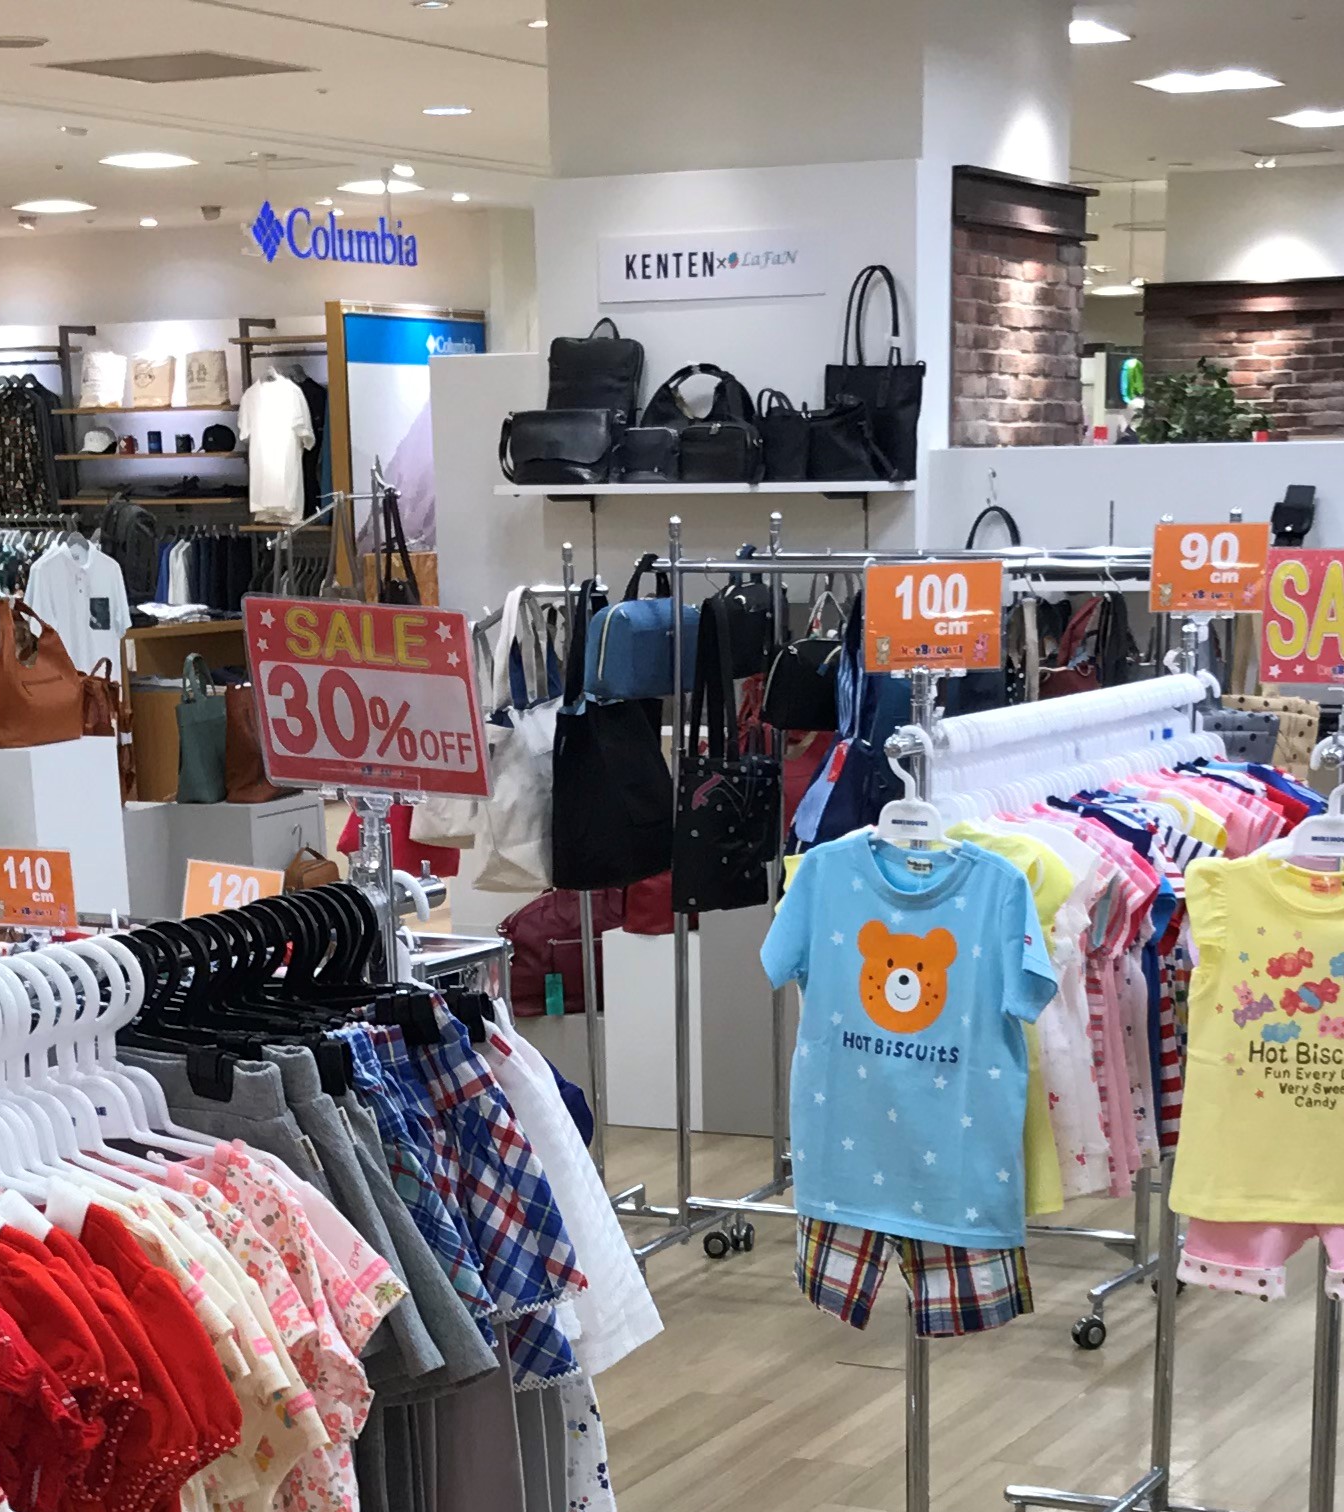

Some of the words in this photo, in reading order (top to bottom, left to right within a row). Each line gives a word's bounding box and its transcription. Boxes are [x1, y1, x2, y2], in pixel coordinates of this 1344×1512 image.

[286, 207, 418, 266] Columbia
[625, 251, 715, 279] KENTEN
[1180, 532, 1240, 570] 90
[1210, 570, 1239, 584] cm
[895, 573, 968, 619] 100
[284, 607, 431, 669] SALE
[934, 620, 968, 636] cm
[3, 856, 52, 891] 110
[31, 891, 55, 903] cm
[208, 871, 260, 909] 120
[1248, 1040, 1288, 1063] Hot
[1264, 1067, 1291, 1079] Fun
[1295, 1067, 1336, 1082] Every
[1278, 1083, 1308, 1097] Very
[1294, 1096, 1337, 1110] Candy
